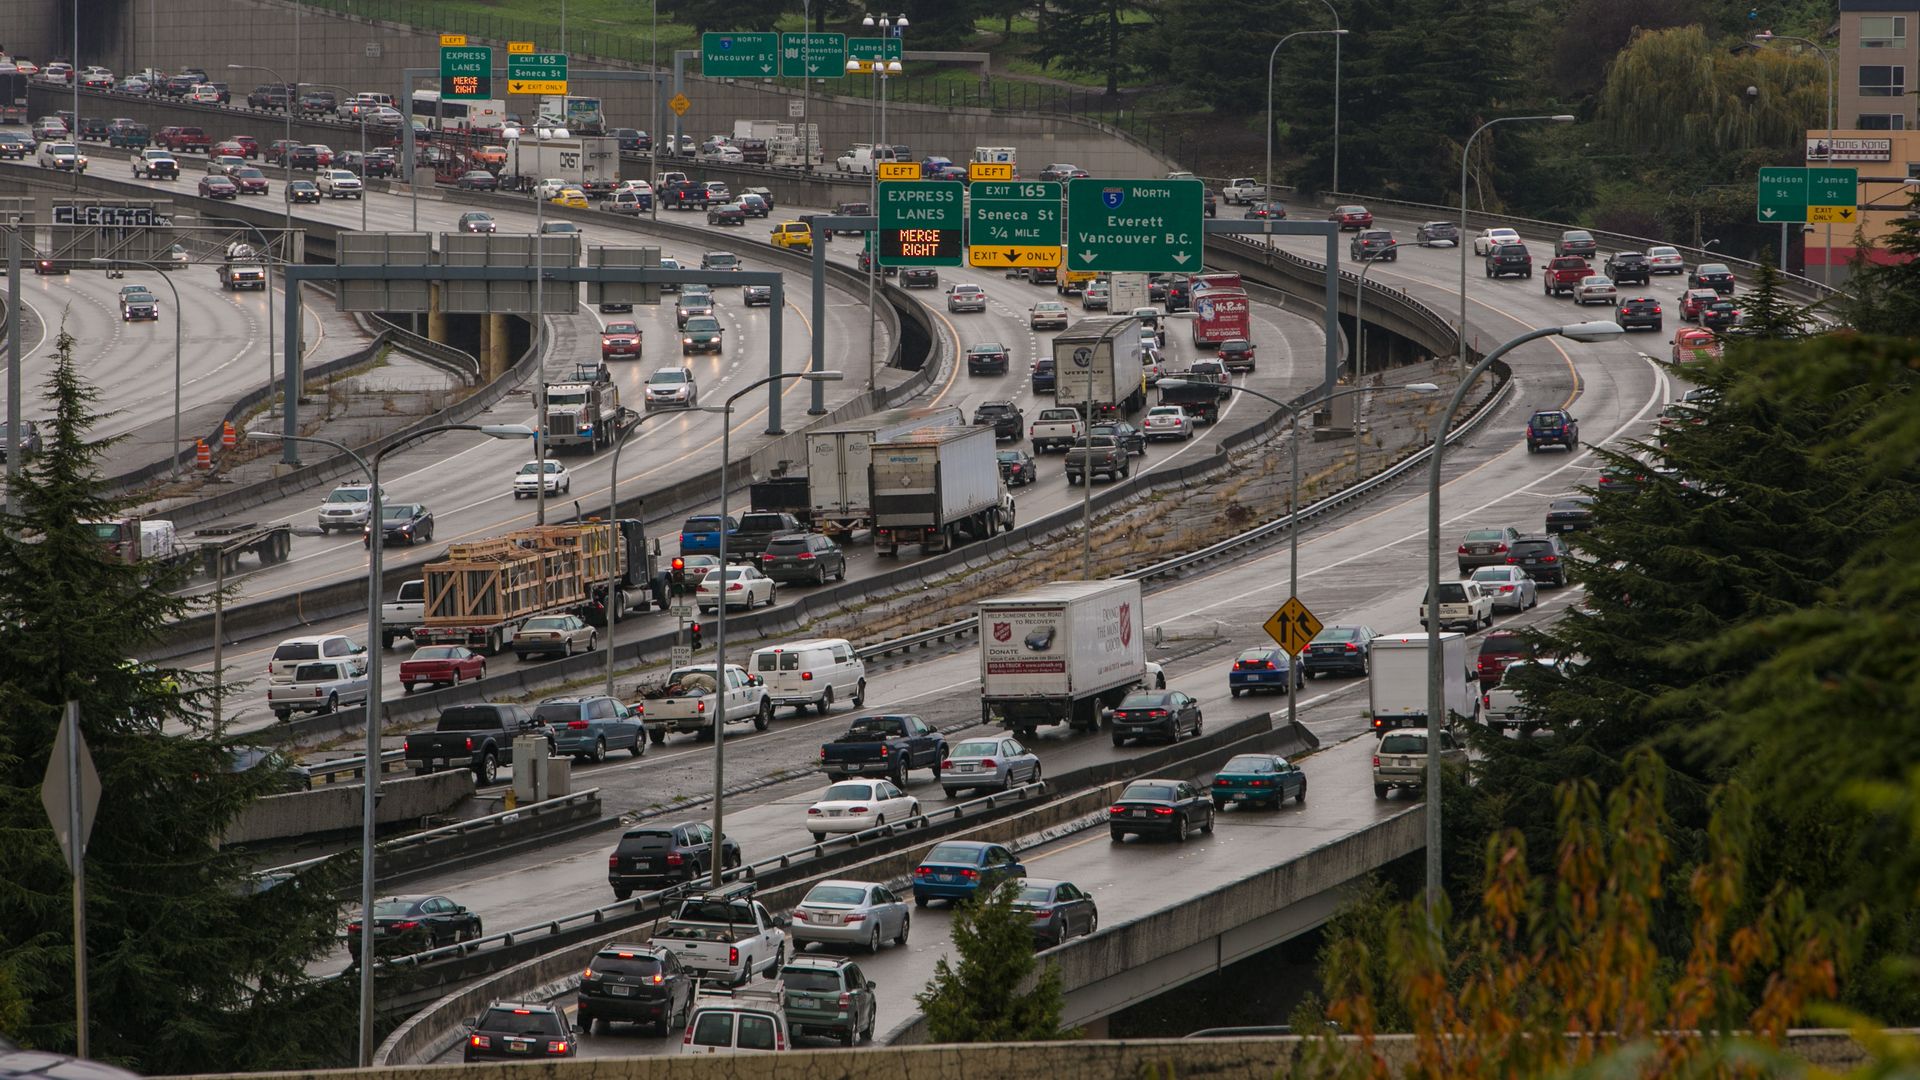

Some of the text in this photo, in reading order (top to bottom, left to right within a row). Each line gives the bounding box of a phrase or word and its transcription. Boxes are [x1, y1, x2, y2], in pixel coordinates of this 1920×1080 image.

[788, 37, 838, 45] Madson St
[446, 52, 486, 60] EXPRESS
[539, 56, 556, 64] 165
[708, 53, 755, 61] Vancouver
[451, 63, 481, 71] LANES
[515, 69, 561, 77] Seneca St
[453, 76, 478, 85] MERGE
[455, 85, 477, 94] RIGHT
[1831, 140, 1887, 150] HONG KONG
[886, 167, 914, 176] LEFT
[977, 167, 1005, 176] LEFT
[1762, 175, 1803, 183] Madison
[1817, 176, 1849, 184] James
[986, 184, 1046, 197] EXIT 165
[1132, 187, 1170, 198] NORTH
[888, 190, 954, 202] EXPRESS
[1109, 193, 1117, 204] 5
[896, 208, 945, 220] LANES
[978, 208, 1054, 221] Seneca St
[1107, 215, 1164, 227] Everett
[900, 229, 940, 242] MERGE
[1014, 228, 1040, 238] MILE
[1079, 232, 1192, 245] Vancouver B.C.
[903, 243, 939, 256] RIGHT
[974, 251, 1056, 261] EXIT ONLY
[1226, 301, 1246, 312] Rooter
